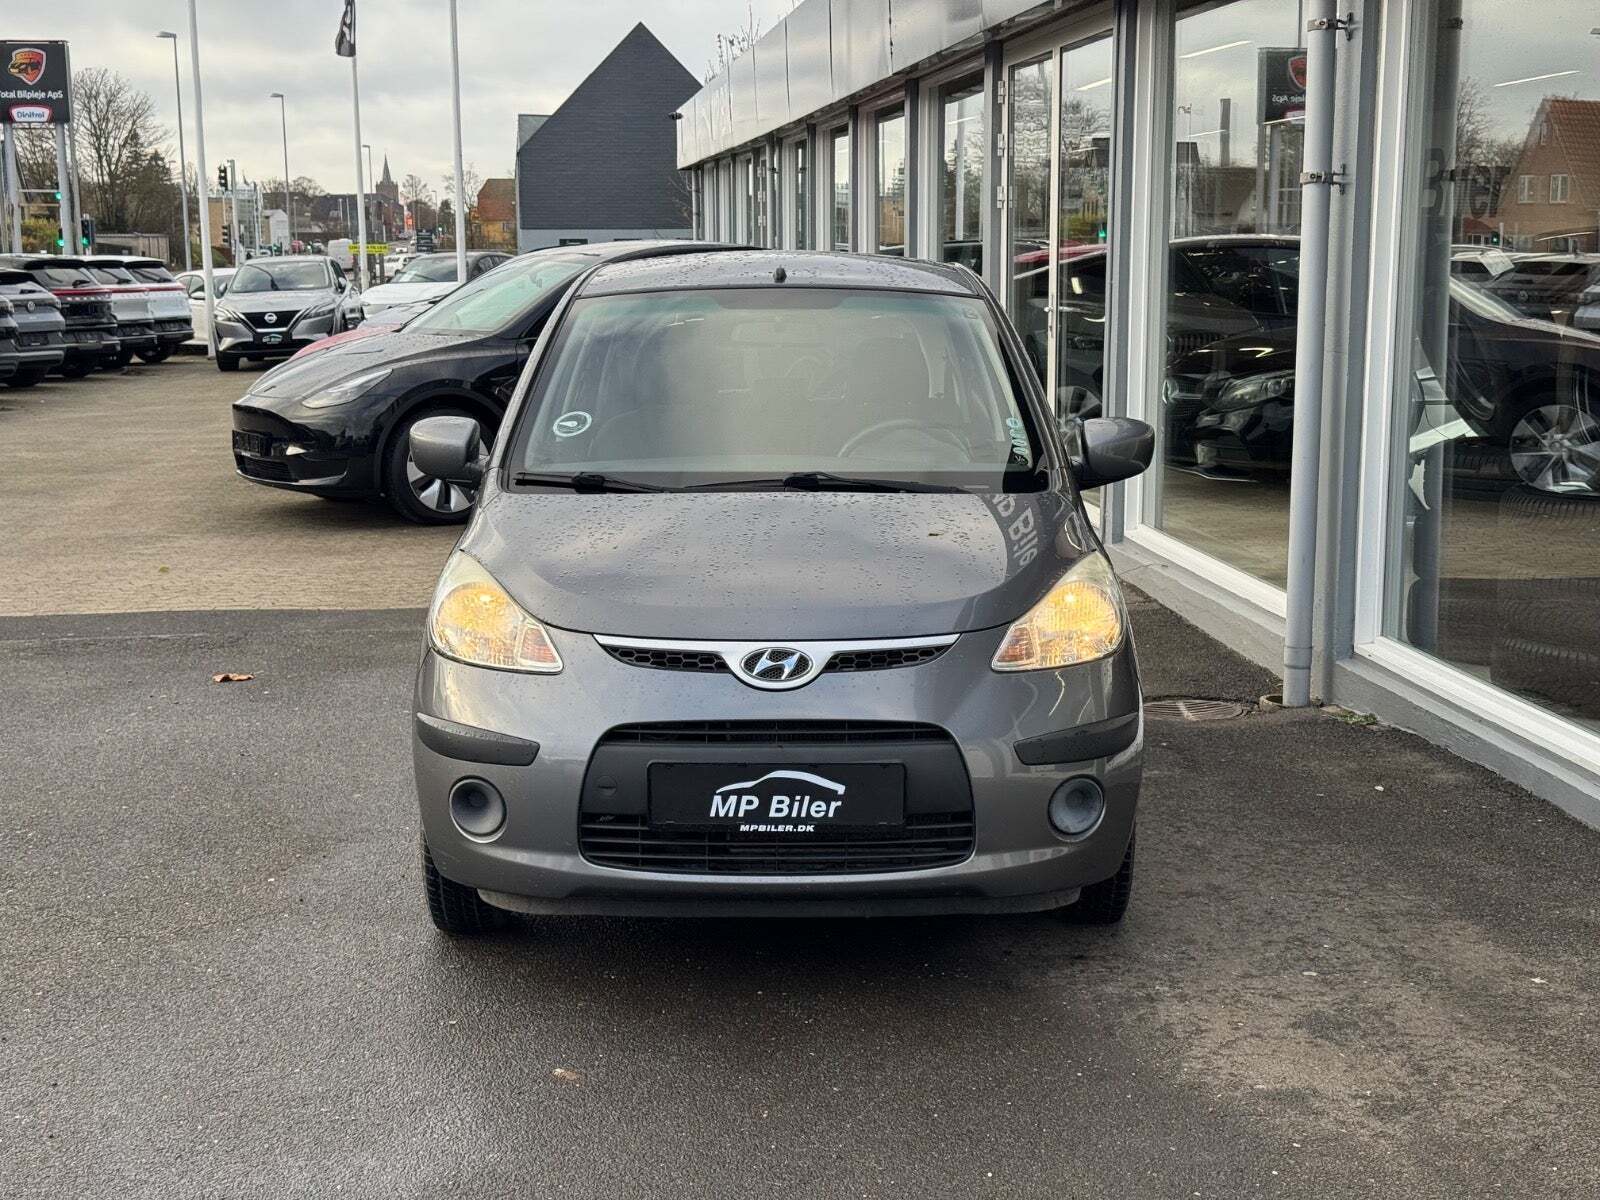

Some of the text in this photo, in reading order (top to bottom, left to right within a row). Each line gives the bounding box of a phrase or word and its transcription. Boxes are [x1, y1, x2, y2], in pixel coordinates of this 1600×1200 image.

[47, 90, 63, 99] ApS
[709, 795, 842, 818] MP Biler
[739, 824, 815, 832] MPBILER.DK
